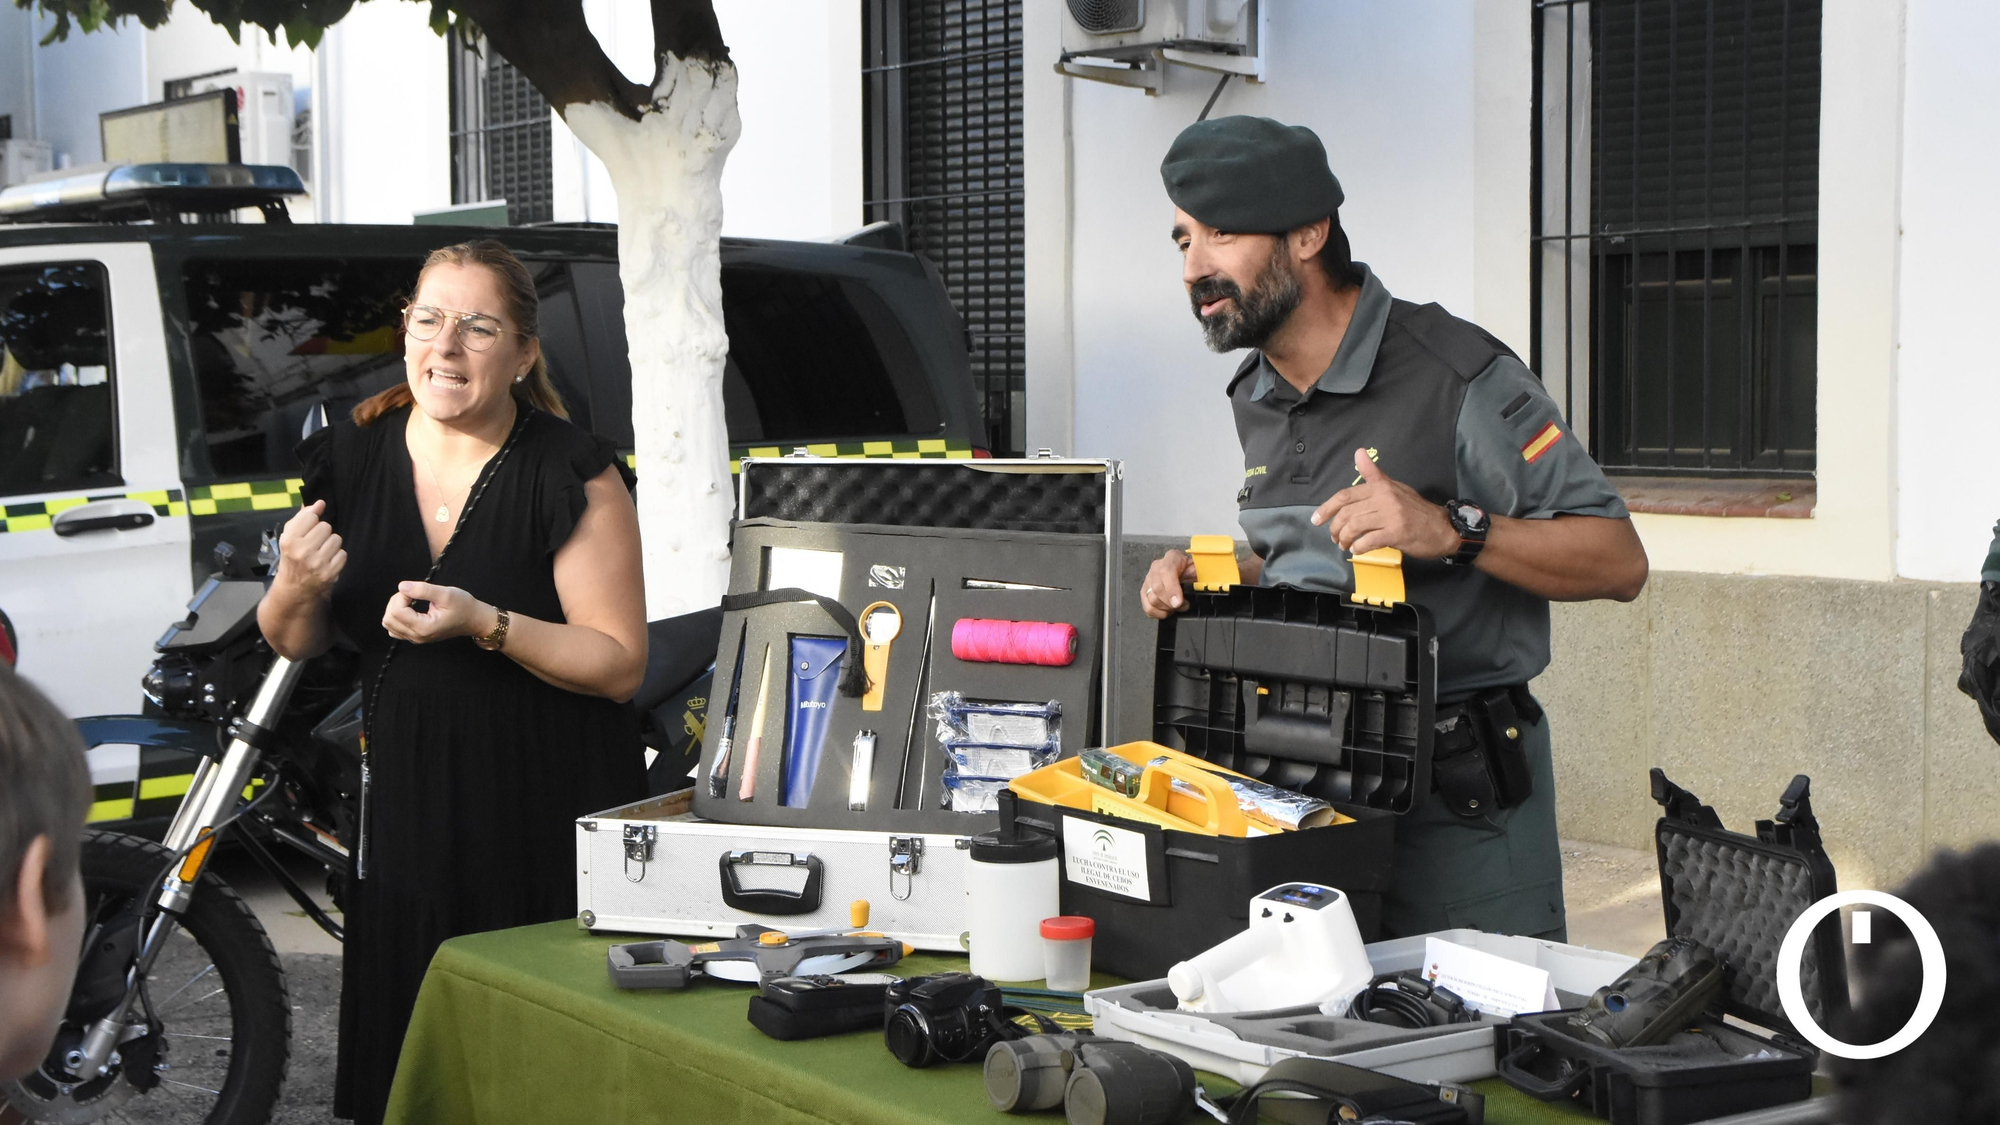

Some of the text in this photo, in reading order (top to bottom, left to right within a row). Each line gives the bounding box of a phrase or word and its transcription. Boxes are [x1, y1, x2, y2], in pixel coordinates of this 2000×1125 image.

[1072, 856, 1092, 867] LUCHA
[1093, 862, 1117, 873] CONTRA
[1118, 867, 1126, 875] EL
[1127, 869, 1140, 878] USO
[1080, 866, 1133, 885] ILEGAL DE CEBOS
[1085, 876, 1130, 892] ENVENENADOS
